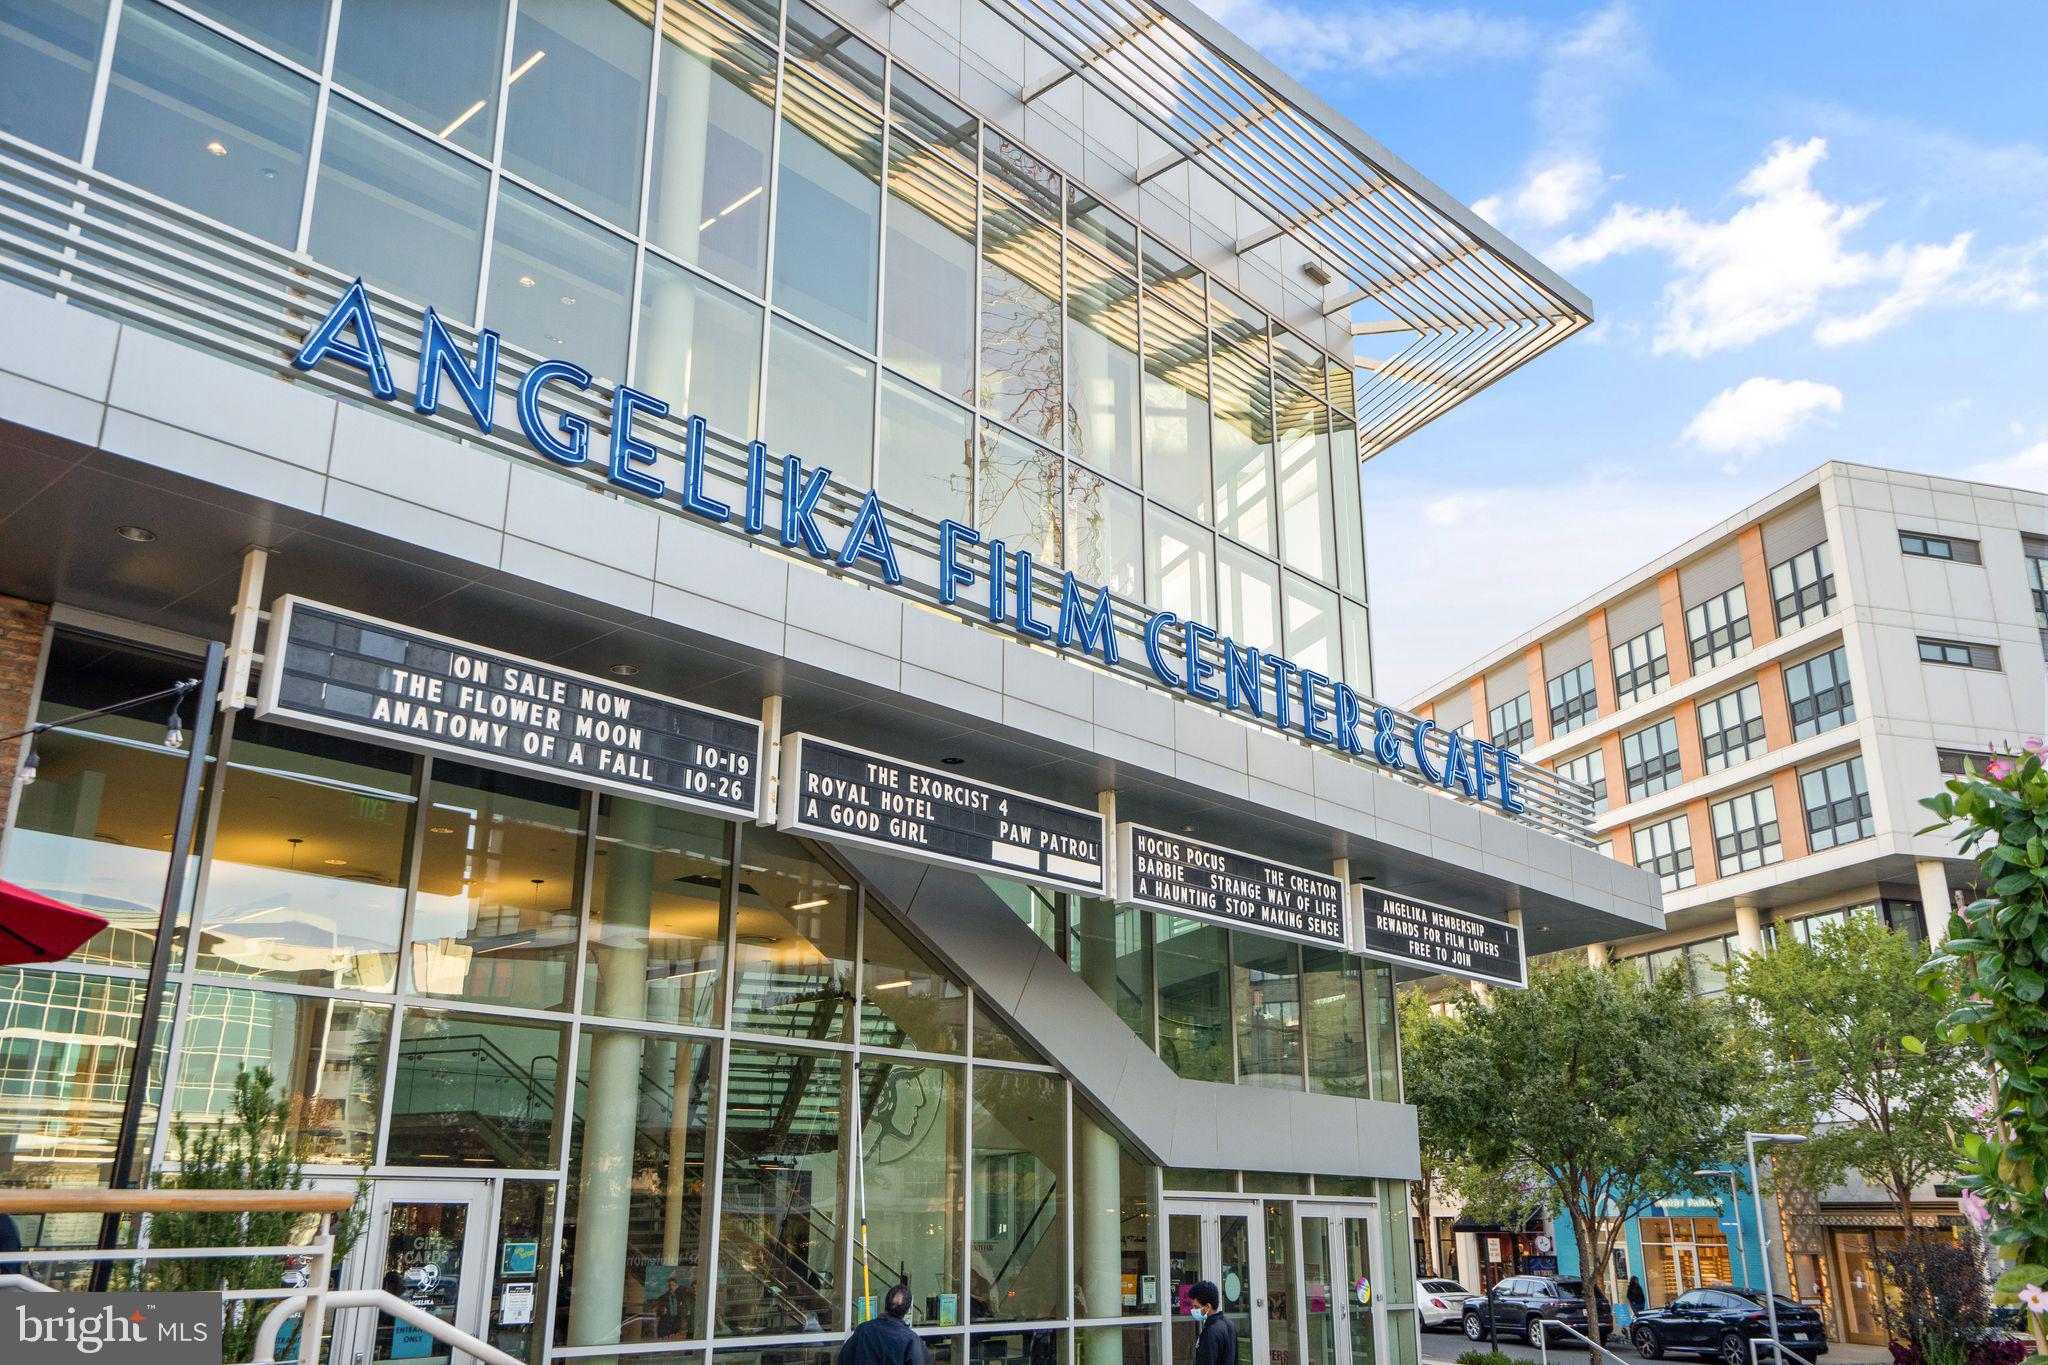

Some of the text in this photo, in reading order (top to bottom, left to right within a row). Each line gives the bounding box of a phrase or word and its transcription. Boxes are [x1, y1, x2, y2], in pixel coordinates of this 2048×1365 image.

[290, 276, 1525, 814] ANGELIKA FILM CENTER & CAFE
[454, 656, 631, 719] ON SALE NOW
[372, 698, 742, 801] ANATOMY OF A FALL 10-26
[392, 669, 749, 776] THE FLOWER MOON 10-19
[808, 773, 1096, 860] ROYAL HOTEL PAW PATROL
[867, 763, 1008, 817] THE EXORCIST 4
[806, 799, 928, 844] A GOOD GIRL
[1138, 835, 1337, 900] HOCUS POCUS THE CREATOR
[1138, 857, 1337, 919] BARBIE STRANGE WAY OF LIFE
[1139, 877, 1339, 937] A HAUNTING STOP MAKING SENSE
[1377, 915, 1500, 958] REWARDS FOR FILM LOVERS
[1383, 899, 1485, 937] ANGELIKA MEMBERSHIP
[1409, 940, 1472, 967] FREE TO JOIN
[404, 1250, 449, 1265] CARDS
[403, 1335, 423, 1343] ONLY
